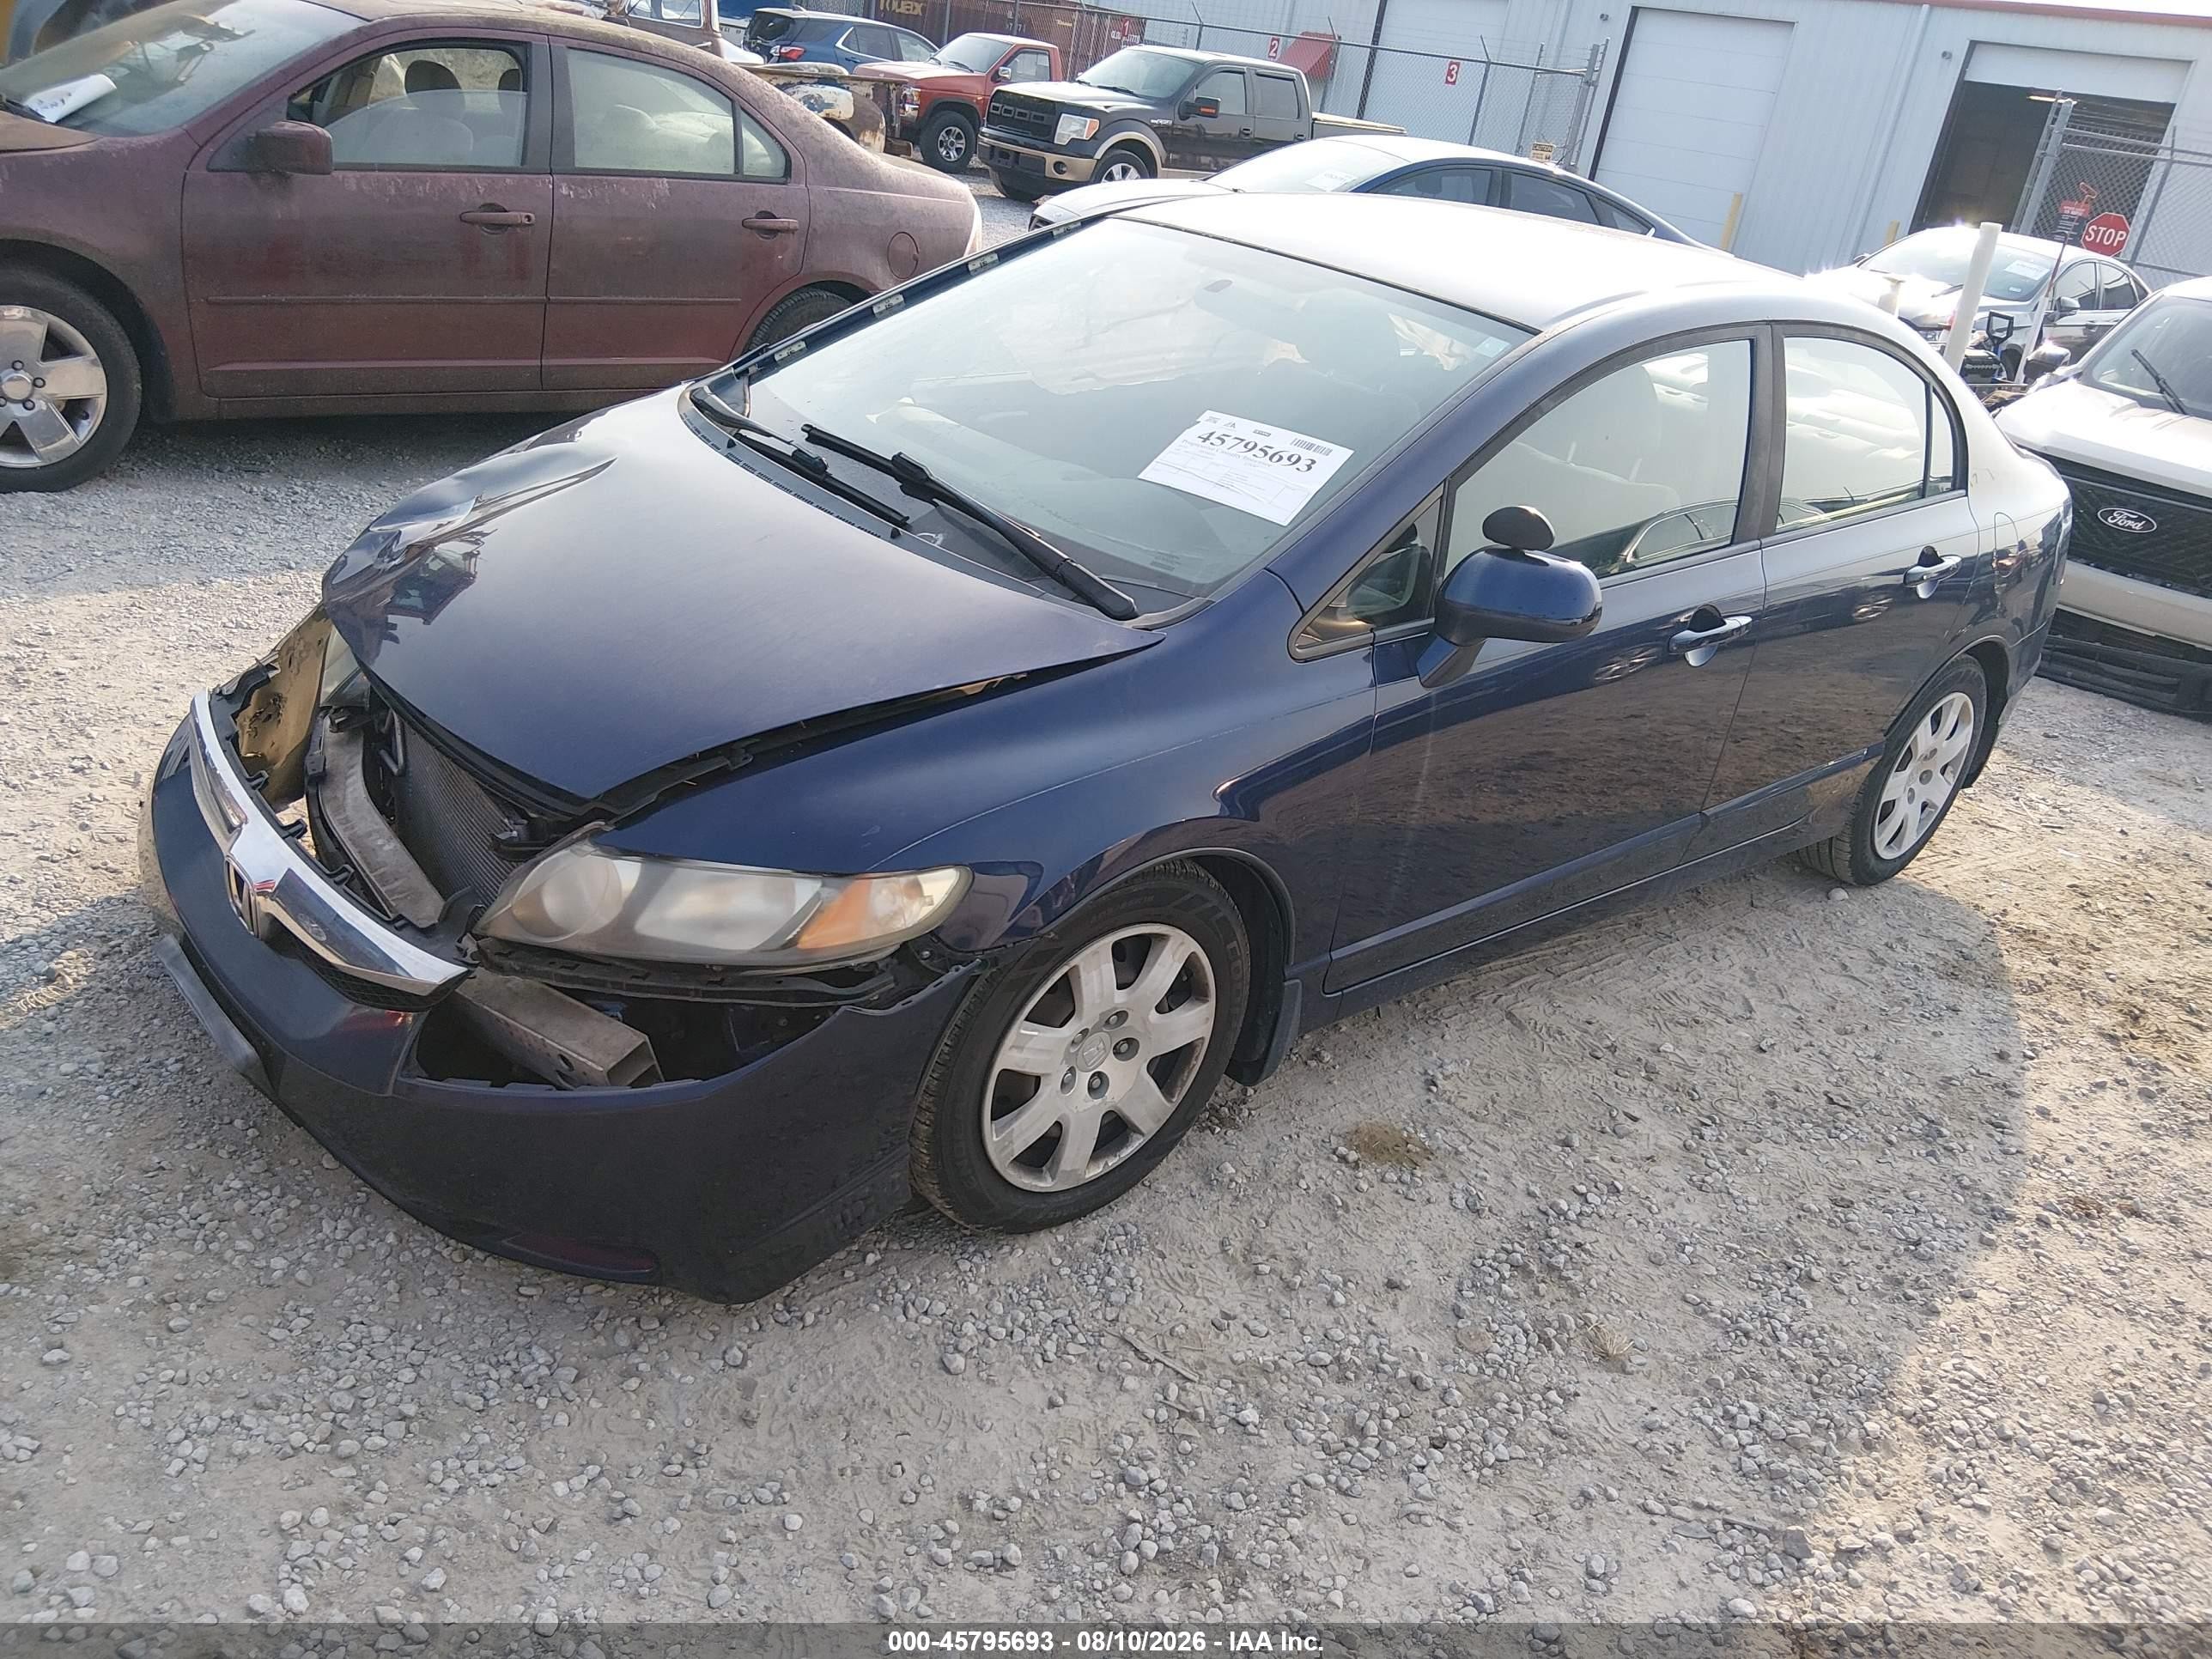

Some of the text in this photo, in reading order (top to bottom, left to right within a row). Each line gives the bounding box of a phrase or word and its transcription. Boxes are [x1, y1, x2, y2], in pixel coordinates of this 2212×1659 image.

[1123, 20, 1130, 36] 1
[1268, 40, 1279, 58] 2
[1447, 64, 1459, 83] 3
[2085, 225, 2127, 246] STOP
[1197, 430, 1317, 473] 45795693
[2107, 510, 2147, 530] Ford
